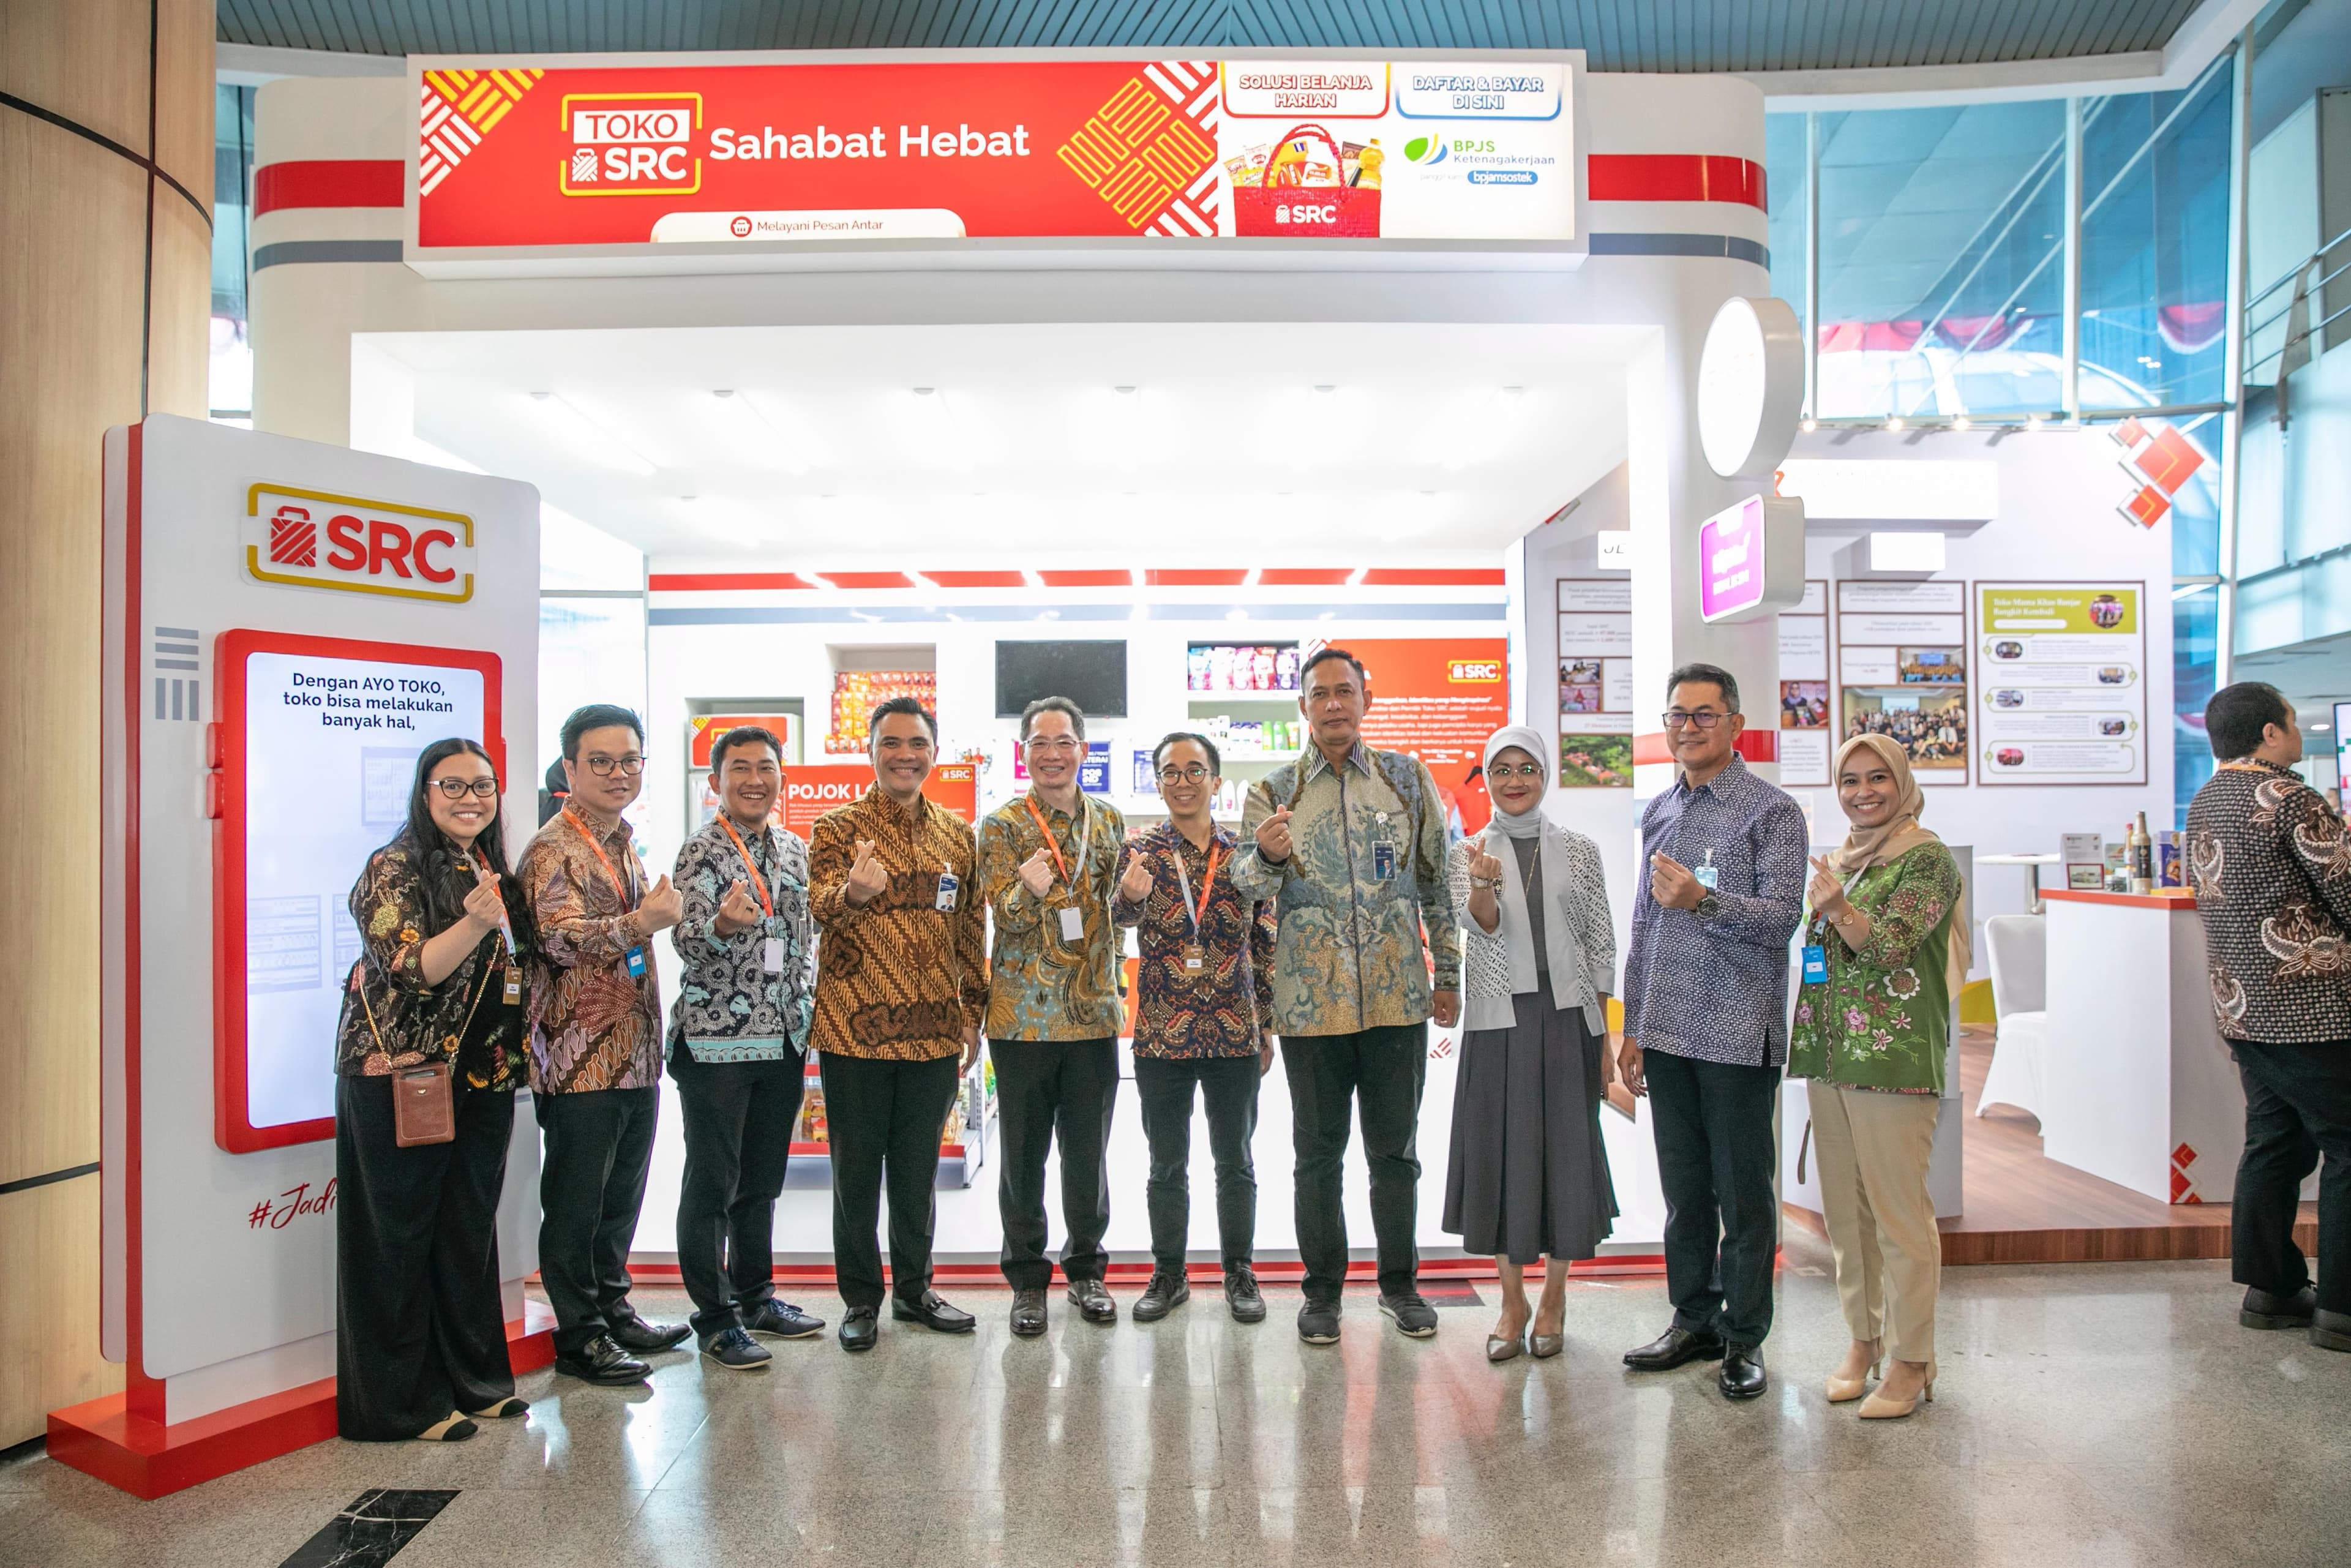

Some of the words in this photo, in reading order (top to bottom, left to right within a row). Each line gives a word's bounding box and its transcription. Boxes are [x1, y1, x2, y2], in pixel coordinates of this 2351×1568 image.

[1239, 75, 1297, 89] SOLUSI
[1300, 75, 1373, 89] BELANJA
[1413, 75, 1475, 91] DAFTAR
[1477, 77, 1490, 91] &
[1492, 77, 1544, 92] BAYAR
[1275, 92, 1337, 108] HARIAN
[1453, 94, 1470, 109] DI
[1472, 94, 1504, 110] SINI
[585, 113, 678, 140] TOKO
[710, 125, 887, 160] Sahabat
[899, 124, 1030, 157] Hebat
[1453, 140, 1495, 152] BPJS
[604, 146, 687, 181] SRC
[1454, 155, 1555, 166] Ketenagakerjaan
[1473, 171, 1533, 184] bpjamsostek
[1292, 204, 1337, 223] SRC
[757, 220, 810, 233] Melayani
[813, 220, 849, 230] Pesan
[852, 219, 883, 230] Antar
[326, 514, 456, 583] SRC
[1464, 664, 1496, 679] SRC
[293, 672, 358, 691] Dengan
[362, 677, 394, 691] AYO
[399, 679, 445, 696] TOKO,
[283, 691, 321, 706] toko
[327, 694, 361, 708] bisa
[366, 697, 453, 713] melakukan
[323, 712, 382, 730] banyak
[387, 715, 415, 731] hal,
[950, 770, 970, 779] SRC
[788, 783, 851, 800] POJOK
